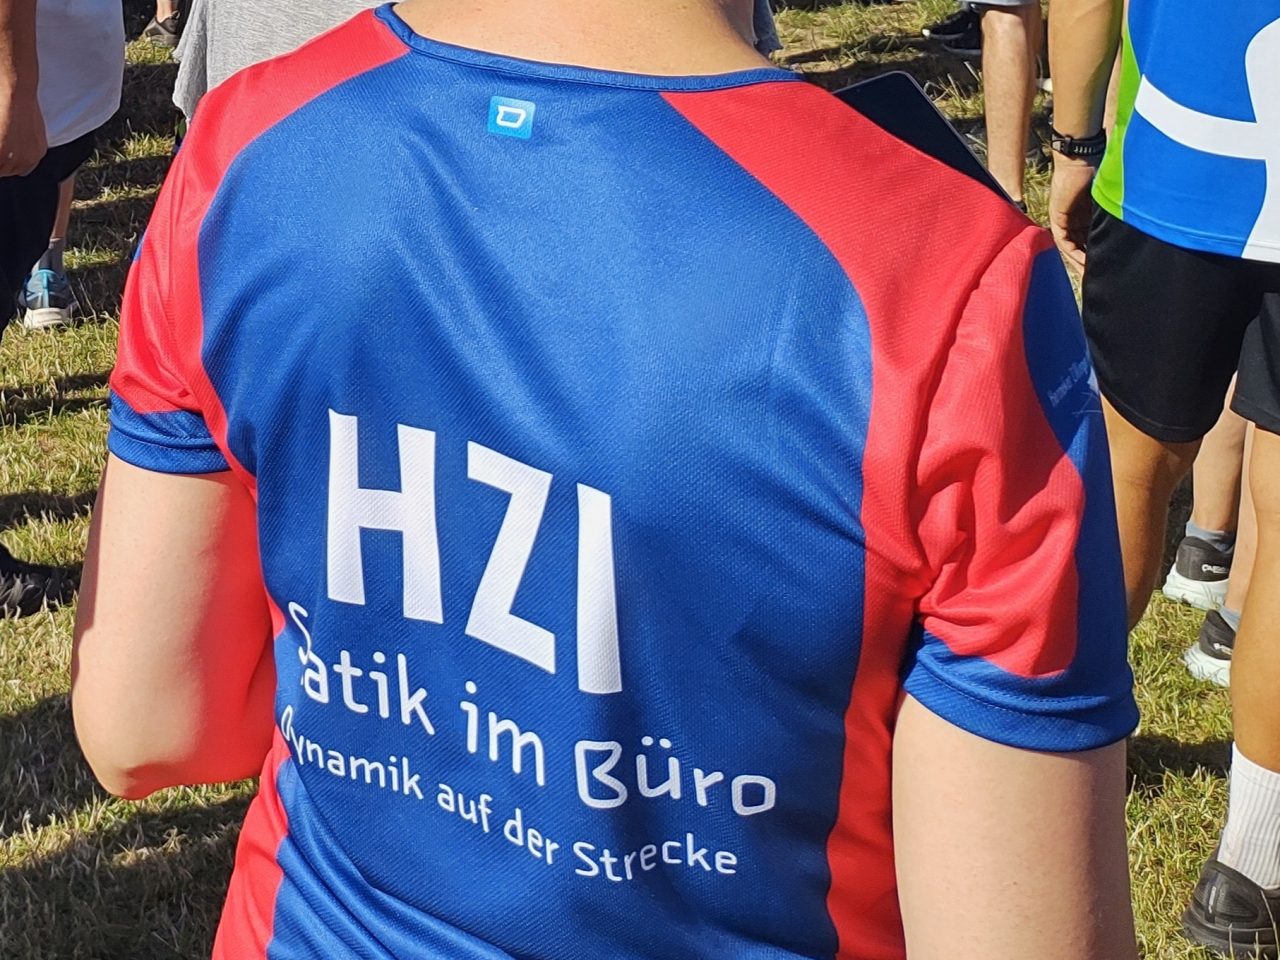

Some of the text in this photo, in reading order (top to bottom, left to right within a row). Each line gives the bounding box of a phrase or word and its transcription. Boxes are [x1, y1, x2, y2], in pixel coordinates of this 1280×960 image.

[327, 408, 622, 694] HZI
[281, 704, 738, 882] Dynamik auf der Strecke
[460, 681, 545, 787] im
[574, 736, 777, 816] Büro
